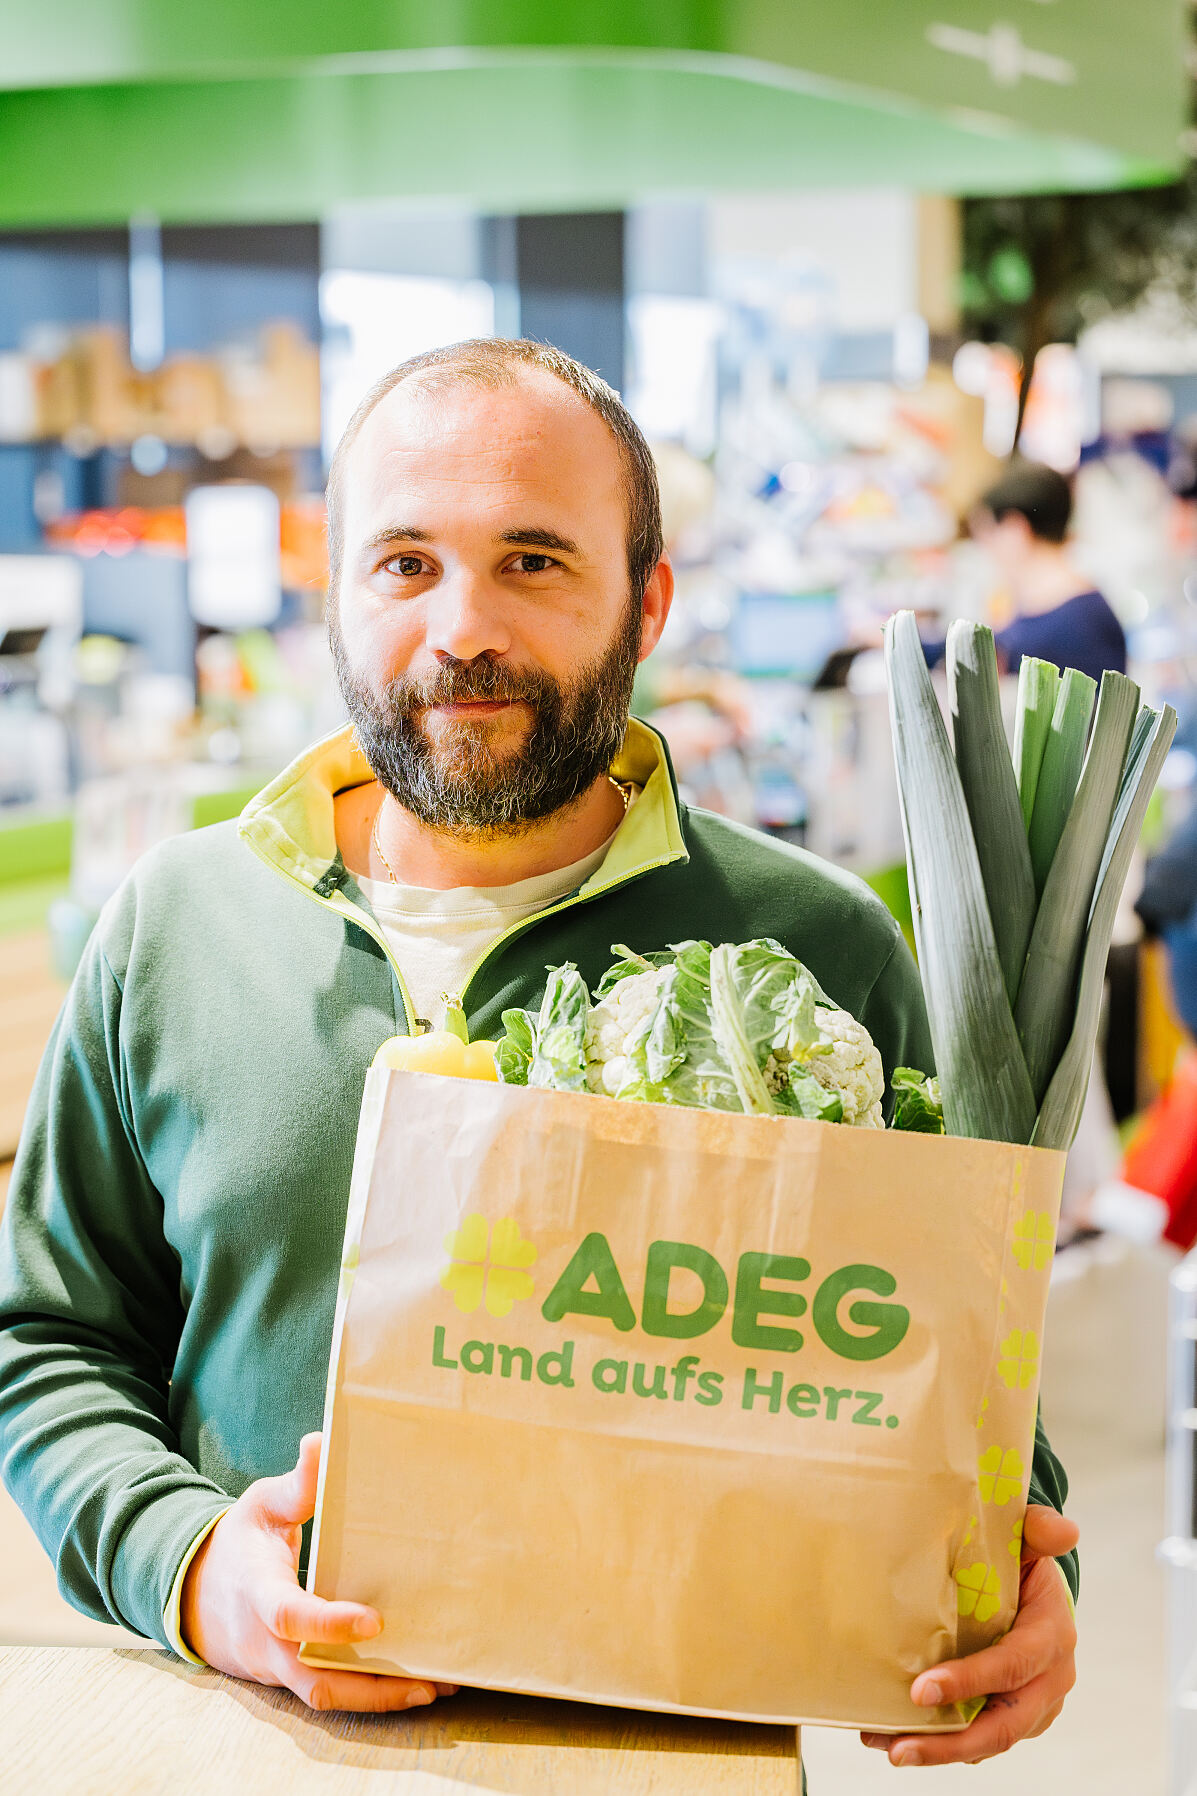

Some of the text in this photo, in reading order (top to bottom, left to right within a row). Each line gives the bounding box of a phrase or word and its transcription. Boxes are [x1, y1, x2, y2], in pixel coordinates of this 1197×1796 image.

[542, 1232, 910, 1361] ADEG
[432, 1325, 900, 1429] Land aufs Herz.
